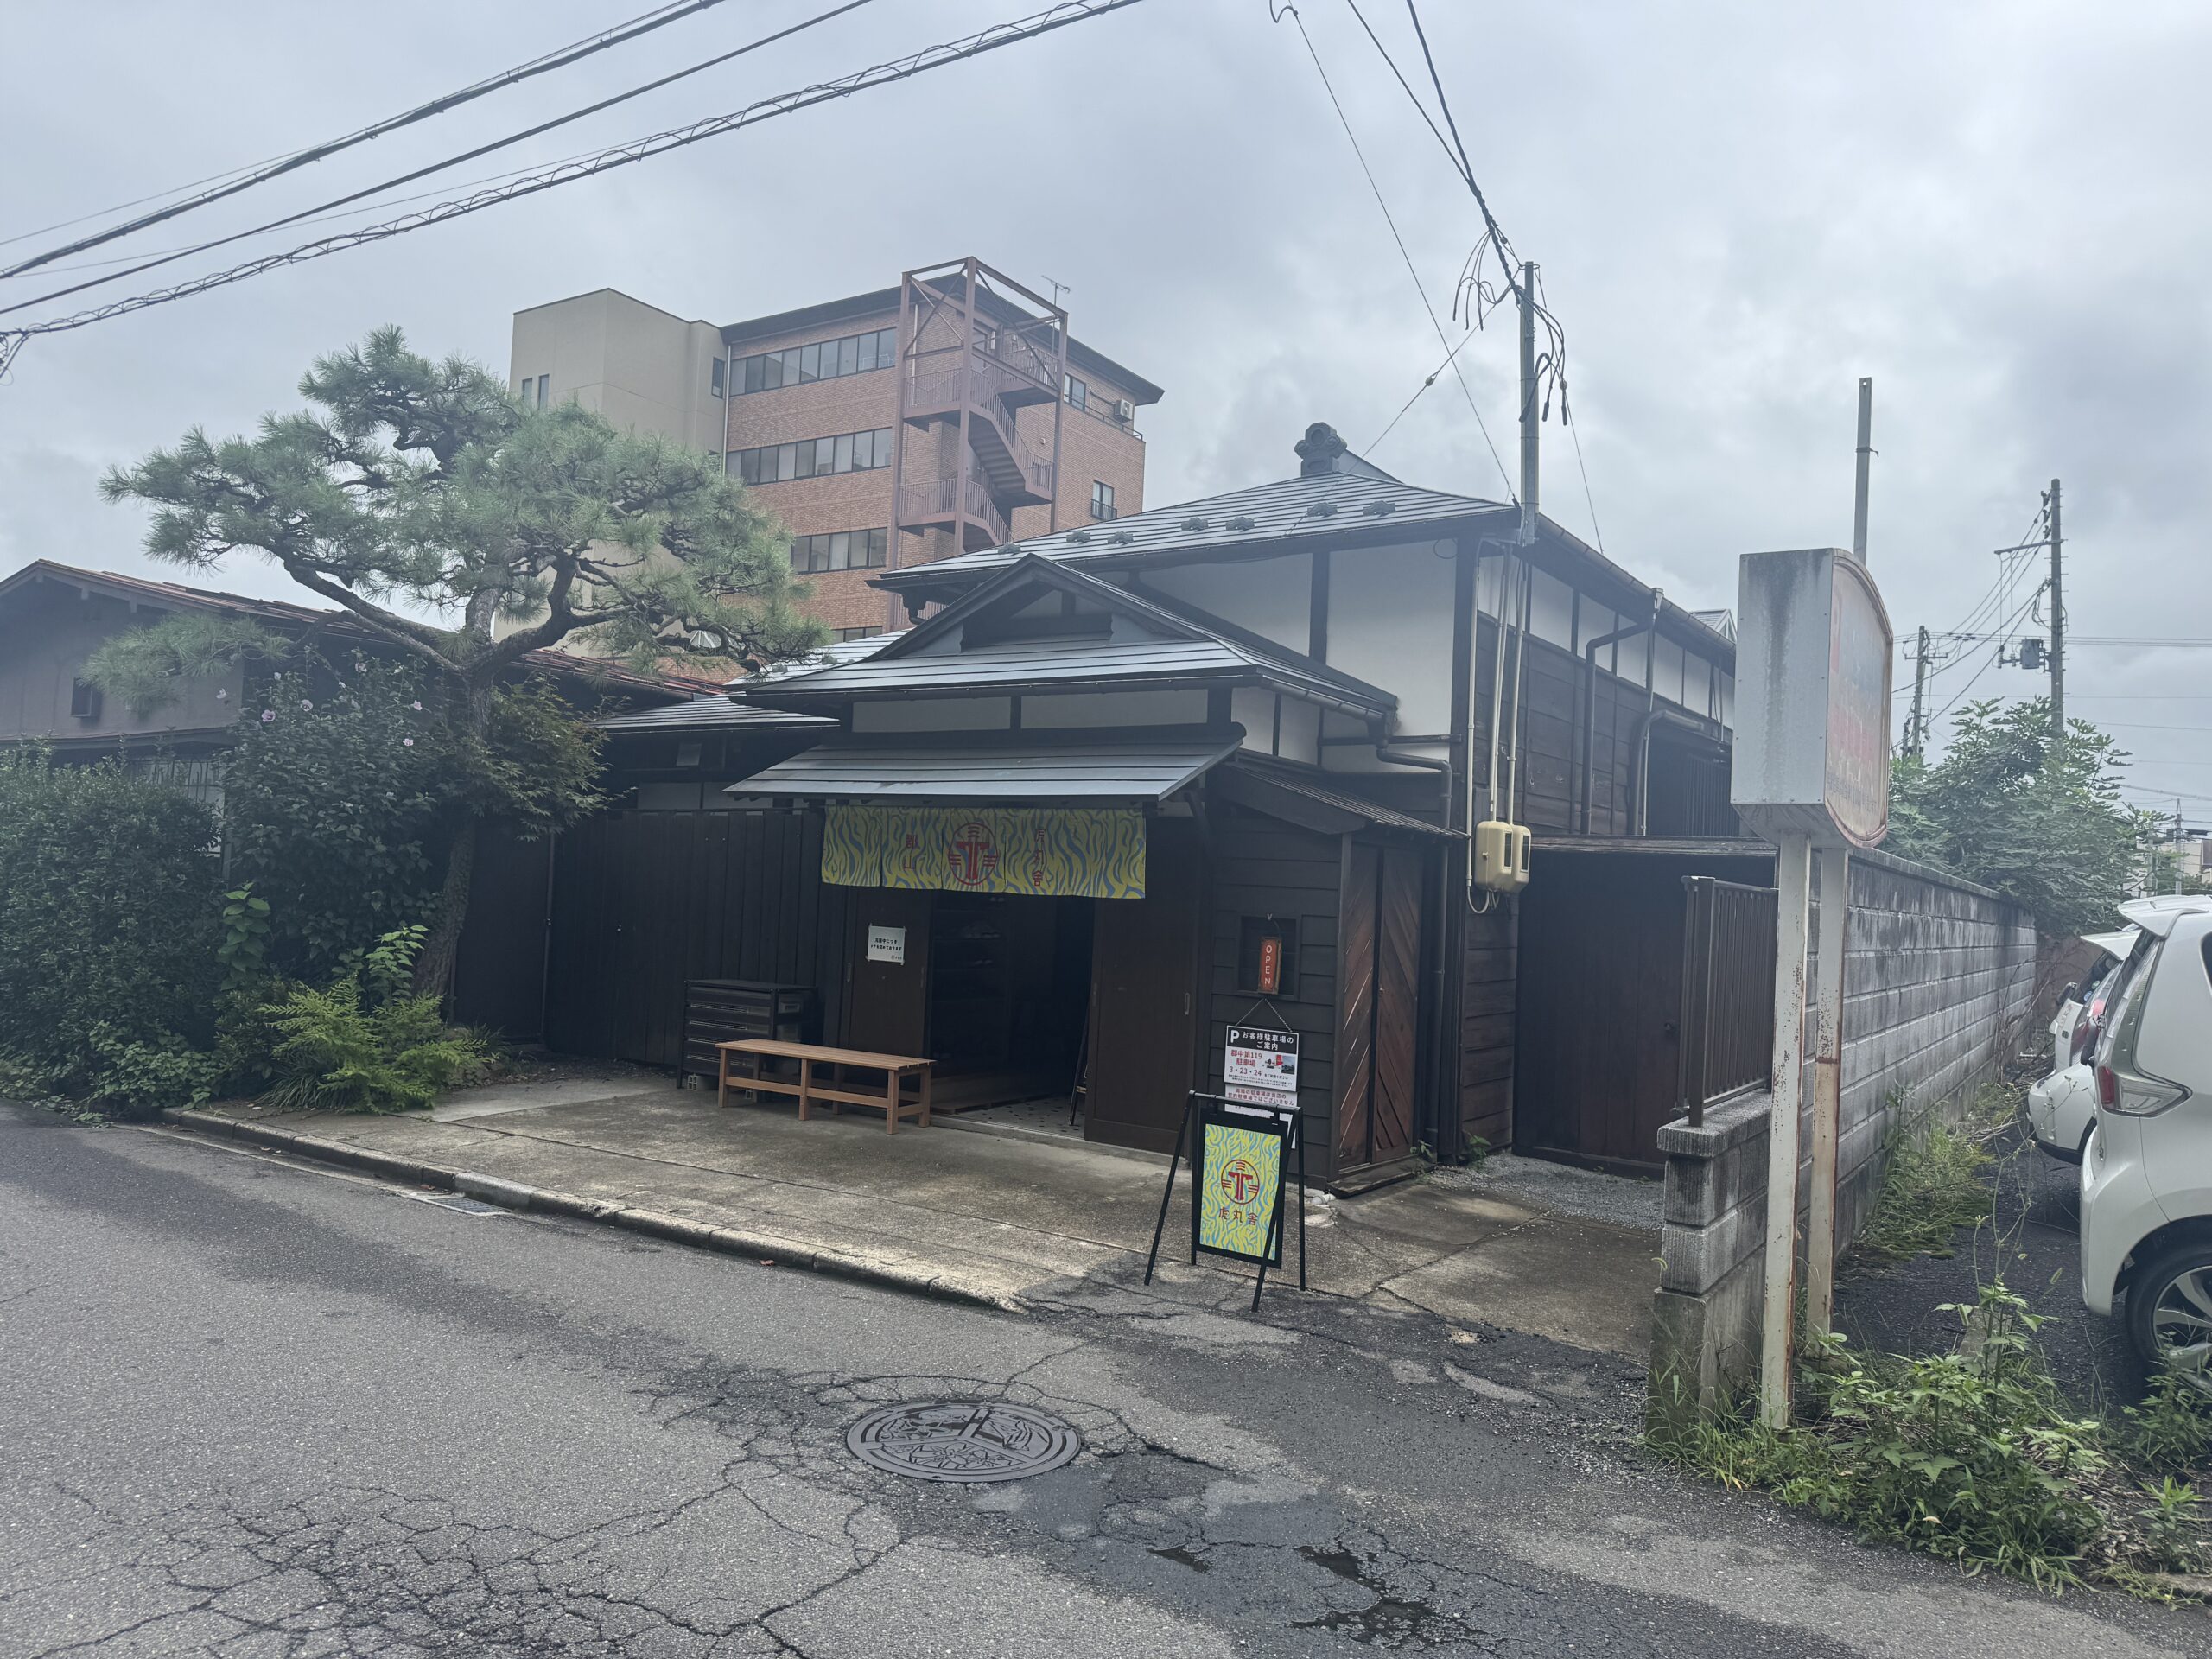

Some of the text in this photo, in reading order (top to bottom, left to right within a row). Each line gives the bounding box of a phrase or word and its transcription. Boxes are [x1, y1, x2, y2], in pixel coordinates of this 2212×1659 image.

[1264, 944, 1273, 984] OPEN
[1242, 1032, 1294, 1044] お客様駐車場の
[1256, 1041, 1279, 1051] ご案内
[1218, 1206, 1258, 1226] 虎丸舎
